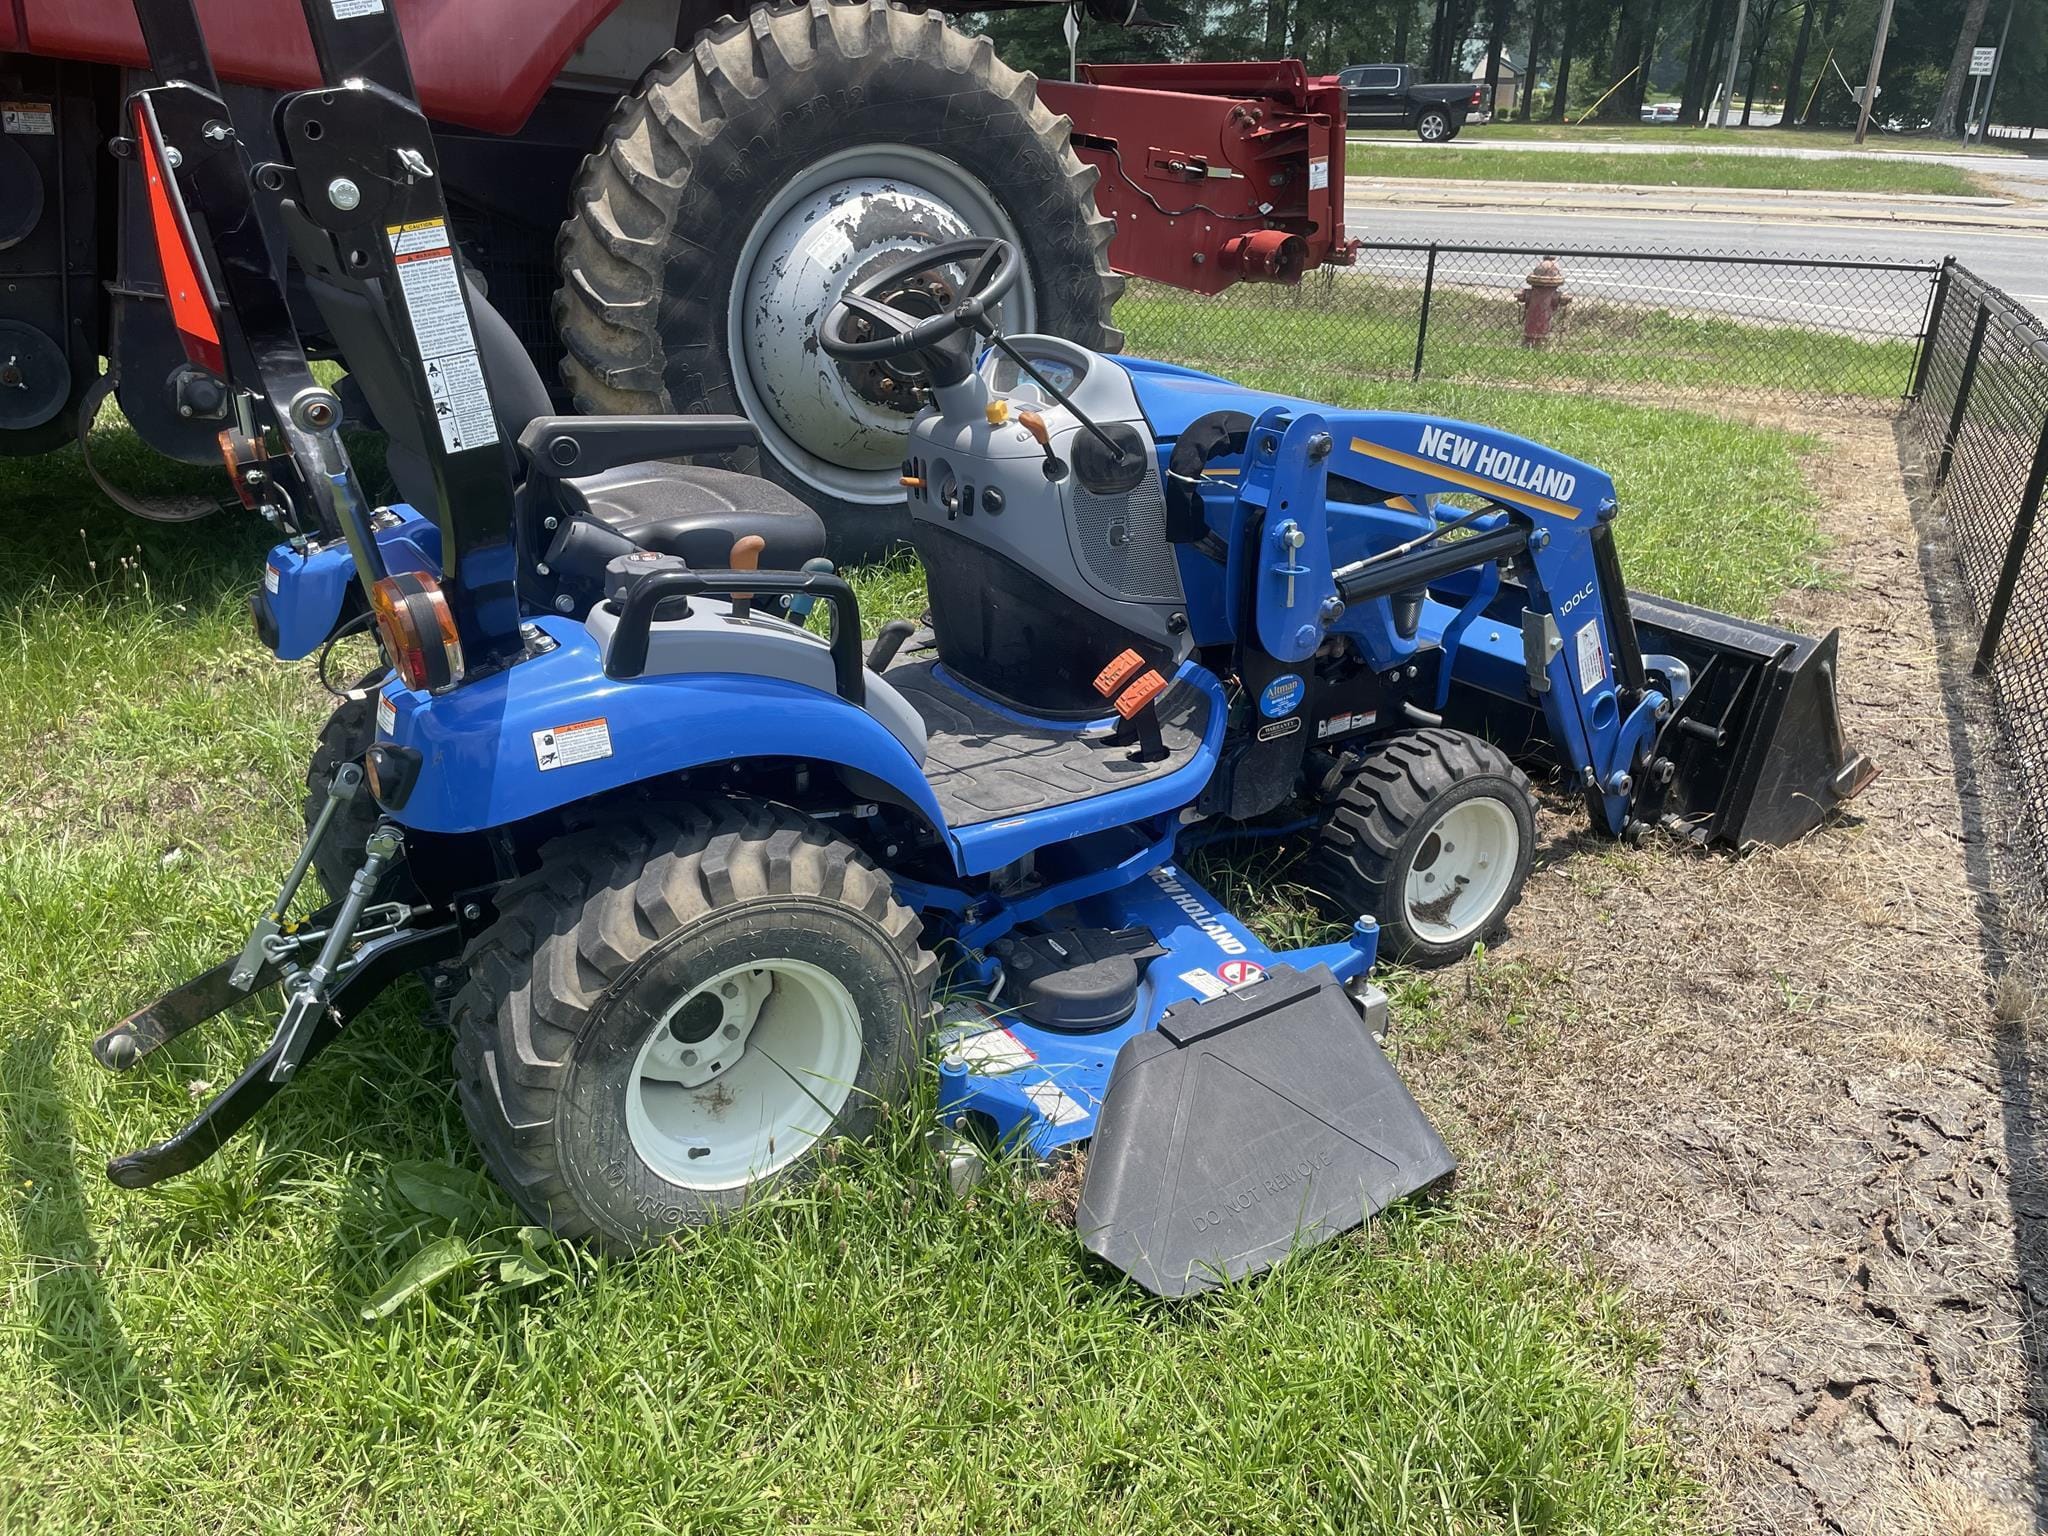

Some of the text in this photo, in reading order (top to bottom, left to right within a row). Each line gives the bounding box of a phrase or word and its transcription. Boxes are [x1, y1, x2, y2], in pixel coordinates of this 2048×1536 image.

[1417, 424, 1576, 501] NEW HOLLAND
[1560, 581, 1594, 616] 100LC
[1171, 893, 1247, 955] HOLLAND
[1191, 1151, 1333, 1233] DO NOT REMOVE
